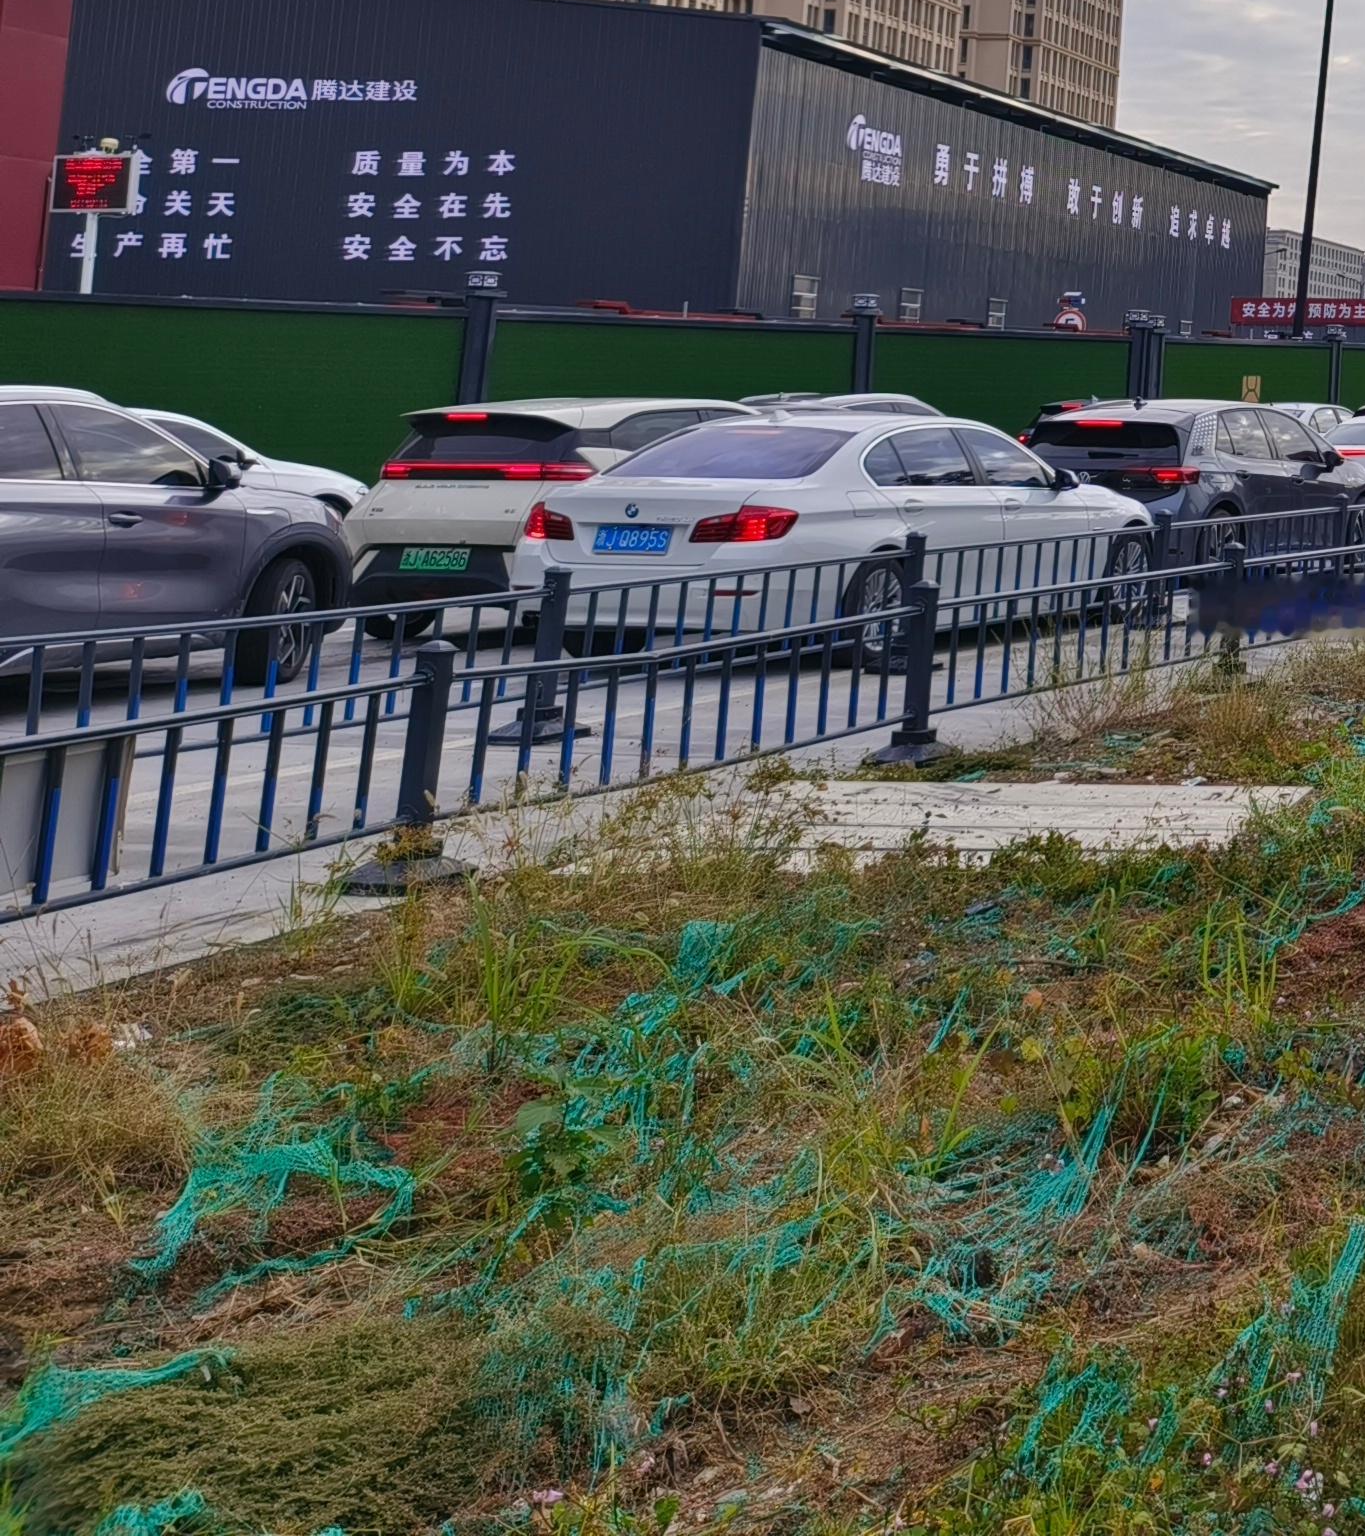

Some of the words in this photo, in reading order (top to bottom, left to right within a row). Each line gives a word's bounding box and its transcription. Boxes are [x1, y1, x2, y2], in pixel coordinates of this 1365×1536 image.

[311, 79, 418, 102] 腾达建设
[206, 100, 307, 110] CONSTRUCTION
[82, 148, 240, 175] 全第一
[352, 149, 516, 176] 质量为本
[347, 192, 512, 219] 安全在先
[933, 143, 1035, 205] 勇于拼搏
[1066, 177, 1144, 230] 敢于创新
[1169, 204, 1231, 250] 追求卓越
[342, 234, 509, 261] 安全不忘
